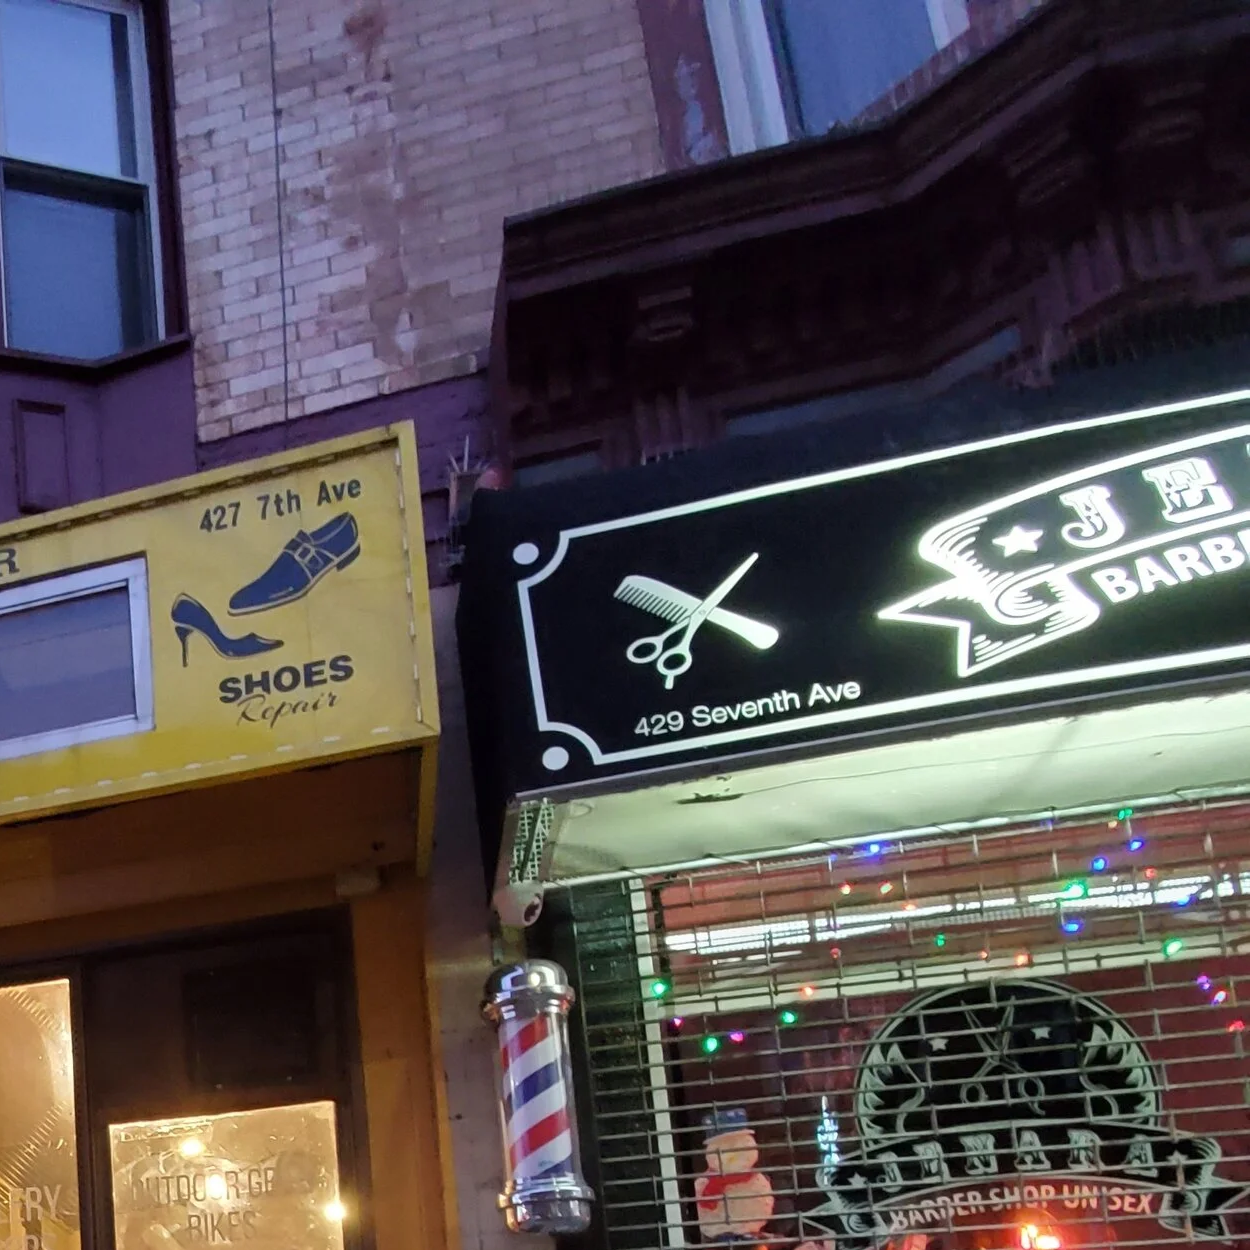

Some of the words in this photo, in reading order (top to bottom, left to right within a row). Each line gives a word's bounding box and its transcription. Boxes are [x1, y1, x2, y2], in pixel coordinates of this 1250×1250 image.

[200, 502, 241, 533] 427
[257, 489, 301, 520] 7th
[317, 479, 361, 506] Ave
[1059, 442, 1250, 549] JE
[219, 655, 354, 703] SHOES
[236, 692, 337, 728] Repair
[634, 710, 684, 737] 429
[691, 689, 801, 727] Seventh
[808, 681, 861, 706] Ave
[188, 1210, 258, 1243] BIKES
[888, 1190, 986, 1232] BARBER
[988, 1185, 1056, 1213] SHOP
